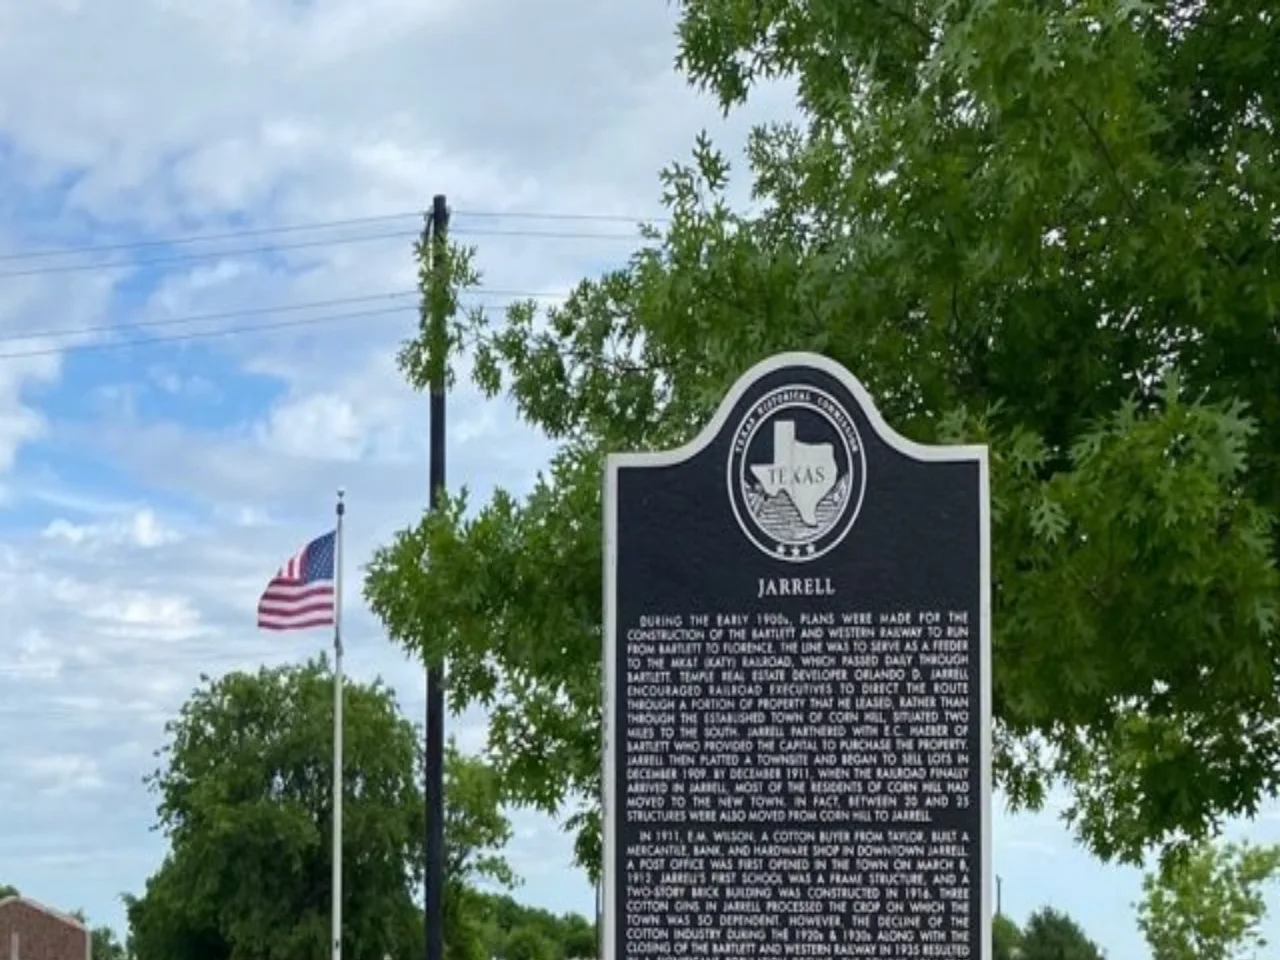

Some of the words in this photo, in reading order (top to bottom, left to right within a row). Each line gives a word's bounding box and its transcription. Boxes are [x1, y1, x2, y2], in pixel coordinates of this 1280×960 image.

[767, 466, 825, 485] TEXAS
[757, 578, 837, 598] JARRELL
[639, 614, 682, 626] DURING
[689, 614, 708, 625] THE
[716, 614, 748, 625] EARLY
[799, 613, 834, 624] PLANS
[841, 612, 872, 624] WERE
[879, 612, 911, 623] MADE
[918, 612, 940, 623] FOR
[948, 611, 968, 623] THE
[627, 628, 704, 640] CONSTRUCTION
[709, 628, 723, 639] OF
[728, 628, 746, 639] THE
[751, 627, 795, 639] BARTLETT
[800, 627, 823, 638] AND
[827, 627, 875, 638] WESTERN
[879, 626, 922, 638] RAILWAY
[927, 626, 942, 637] TO
[946, 626, 968, 637] RUN
[627, 684, 701, 696] ENCOURAGED
[708, 683, 762, 695] RAILROAD
[769, 683, 832, 695] EXECUTIVES
[839, 683, 854, 694] TO
[861, 683, 899, 694] DIRECT
[906, 682, 926, 694] THE
[933, 682, 968, 694] ROUTE
[627, 698, 675, 710] THROUGH
[679, 698, 686, 709] A
[691, 698, 735, 709] PORTION
[739, 698, 752, 709] OF
[757, 697, 805, 709] PROPERTY
[809, 697, 833, 709] THAT
[837, 697, 851, 708] HE
[899, 697, 936, 708] RATHER
[940, 696, 968, 708] THAN
[627, 712, 675, 724] THROUGH
[680, 712, 697, 723] THE
[704, 712, 765, 723] ESTABLISHED
[771, 711, 803, 723] TOWN
[808, 711, 822, 723] OF
[828, 711, 858, 723] CORN
[892, 711, 938, 722] SITUATED
[944, 710, 969, 722] TWO
[626, 739, 669, 751] BARTLETT
[673, 739, 700, 751] WHO
[704, 739, 753, 751] PROVIDED
[757, 739, 774, 751] THE
[779, 739, 817, 751] CAPITAL
[822, 739, 836, 751] TO
[839, 739, 891, 751] PURCHASE
[895, 739, 914, 751] THE
[627, 754, 663, 765] JARRELL
[668, 754, 695, 765] THEN
[699, 754, 739, 765] PLATTED
[744, 754, 751, 765] A
[757, 754, 808, 765] TOWNSITE
[813, 754, 836, 765] AND
[841, 753, 877, 764] BEGAN
[882, 753, 896, 764] TO
[901, 753, 922, 764] SELL
[927, 753, 952, 764] LOTS
[957, 753, 969, 764] IN
[627, 810, 686, 821] STRUCTURES
[688, 810, 716, 821] WERE
[719, 810, 746, 821] ALSO
[748, 810, 785, 821] MOVED
[788, 810, 816, 821] FROM
[819, 810, 849, 821] CORN
[852, 810, 871, 821] HILL
[874, 810, 888, 821] TO
[727, 845, 750, 855] AND
[753, 845, 808, 856] HARDWARE
[812, 845, 839, 856] SHOP
[842, 845, 854, 856] IN
[857, 845, 924, 856] DOWNTOWN
[626, 886, 685, 897] TWO-STORY
[691, 886, 719, 898] BRICK
[725, 886, 772, 898] BUILDING
[778, 886, 800, 898] WAS
[807, 887, 880, 898] CONSTRUCTED
[885, 887, 898, 898] IN
[939, 887, 969, 899] THREE
[626, 900, 668, 911] COTTON
[674, 900, 700, 911] GINS
[705, 900, 716, 911] IN
[723, 900, 760, 912] JARRELL
[765, 901, 823, 912] PROCESSED
[829, 901, 846, 912] THE
[852, 901, 880, 912] CROP
[885, 901, 904, 912] ON
[909, 901, 944, 913] WHICH
[951, 901, 969, 913] THE
[626, 914, 660, 925] TOWN
[666, 914, 690, 925] WAS
[697, 914, 712, 925] SO
[852, 915, 870, 926] THE
[877, 915, 920, 926] DECLINE
[927, 915, 942, 927] OF
[950, 916, 969, 927] THE
[626, 941, 671, 953] CLOSING
[673, 942, 688, 953] OF
[691, 942, 708, 954] THE
[711, 942, 755, 954] BARTLETT
[759, 942, 782, 954] AND
[784, 942, 831, 955] WESTERN
[833, 943, 876, 955] RAILWAY
[879, 943, 891, 955] IN
[895, 943, 920, 955] 1935
[922, 943, 970, 956] RESULTED
